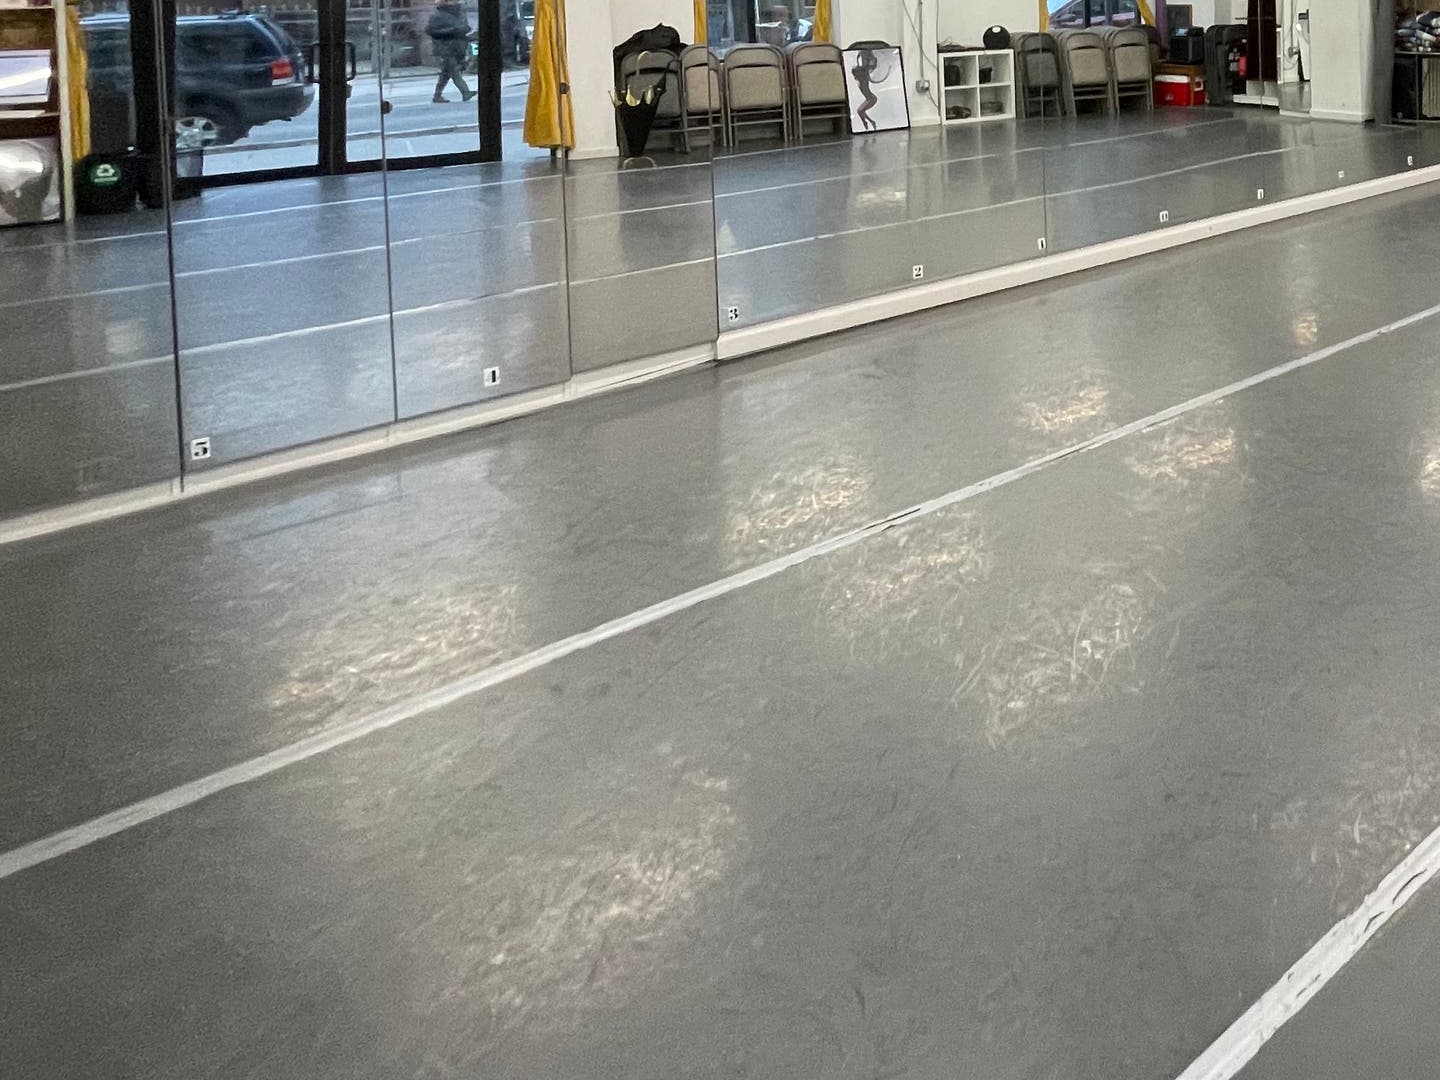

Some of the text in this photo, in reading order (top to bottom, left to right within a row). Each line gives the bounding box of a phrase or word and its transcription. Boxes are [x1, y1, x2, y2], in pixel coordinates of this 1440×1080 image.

[914, 266, 922, 277] 2
[729, 308, 738, 320] 3
[194, 440, 208, 456] 5
